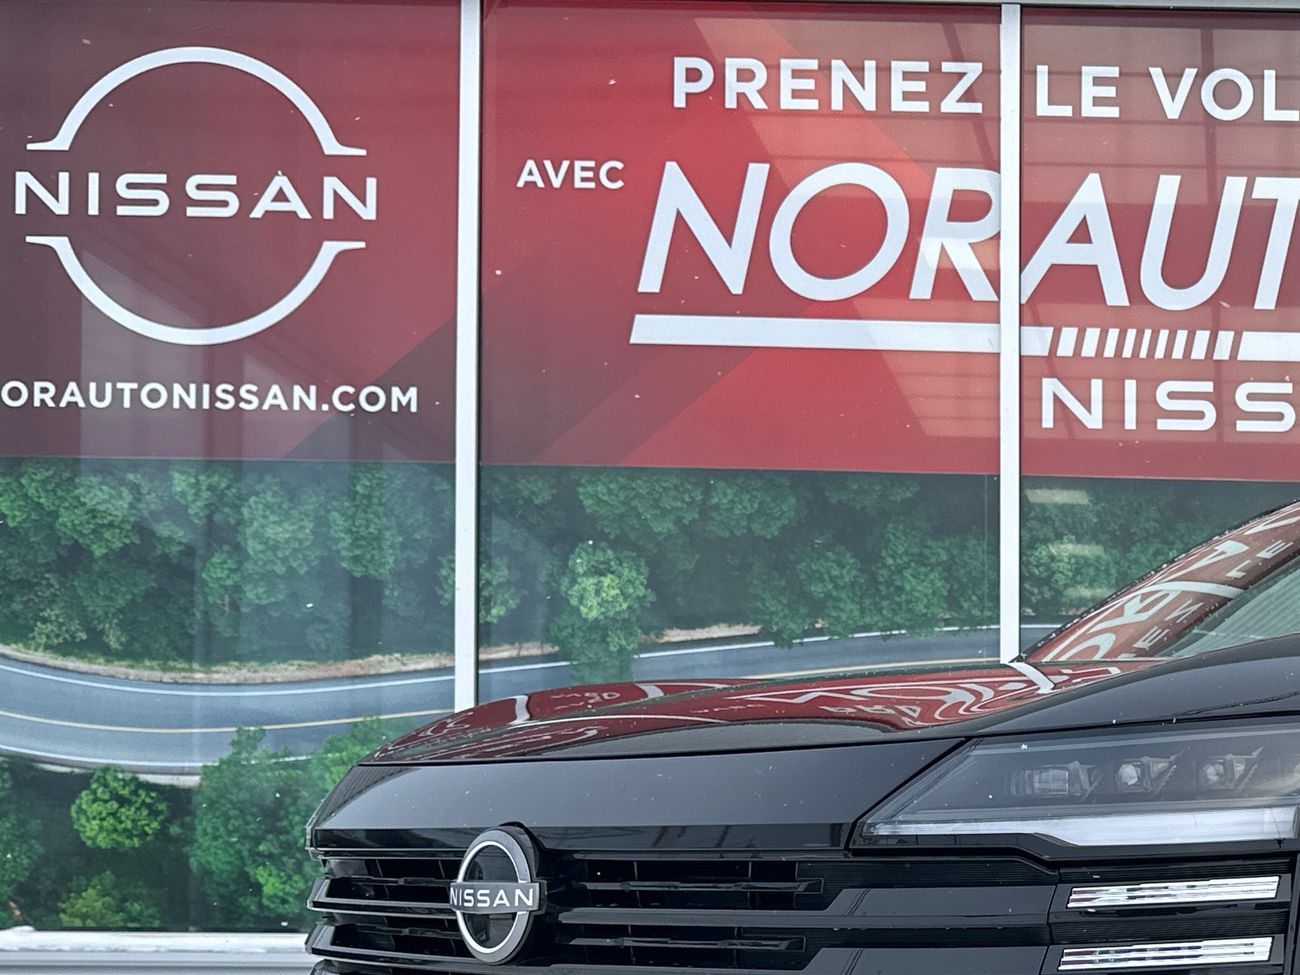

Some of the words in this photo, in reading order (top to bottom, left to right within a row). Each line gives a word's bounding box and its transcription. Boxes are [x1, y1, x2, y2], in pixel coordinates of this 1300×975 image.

[673, 56, 983, 114] PRENEZ
[1036, 64, 1120, 118] LE
[516, 159, 625, 189] AVEC
[14, 170, 377, 221] NISSAN
[1, 380, 418, 413] ORAUTONISSAN.COM
[450, 888, 534, 908] NISSAN
